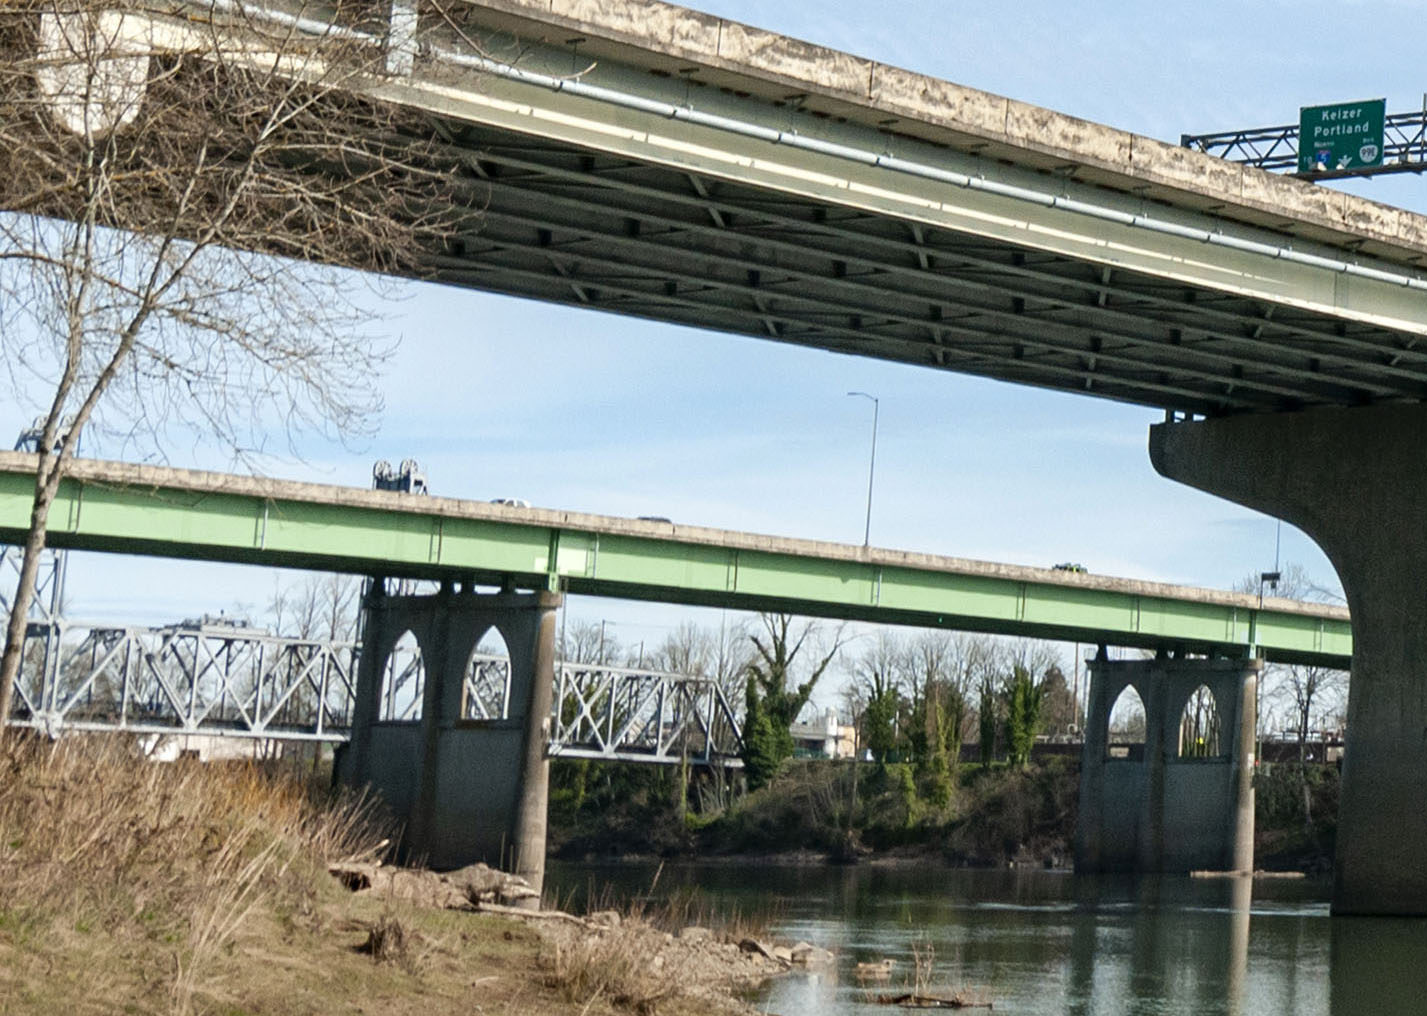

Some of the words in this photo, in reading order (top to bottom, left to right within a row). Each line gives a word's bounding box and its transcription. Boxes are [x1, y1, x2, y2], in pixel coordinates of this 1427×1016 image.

[1322, 108, 1362, 121] Keizer
[1314, 121, 1369, 137] Portland
[1361, 147, 1376, 158] 99E
